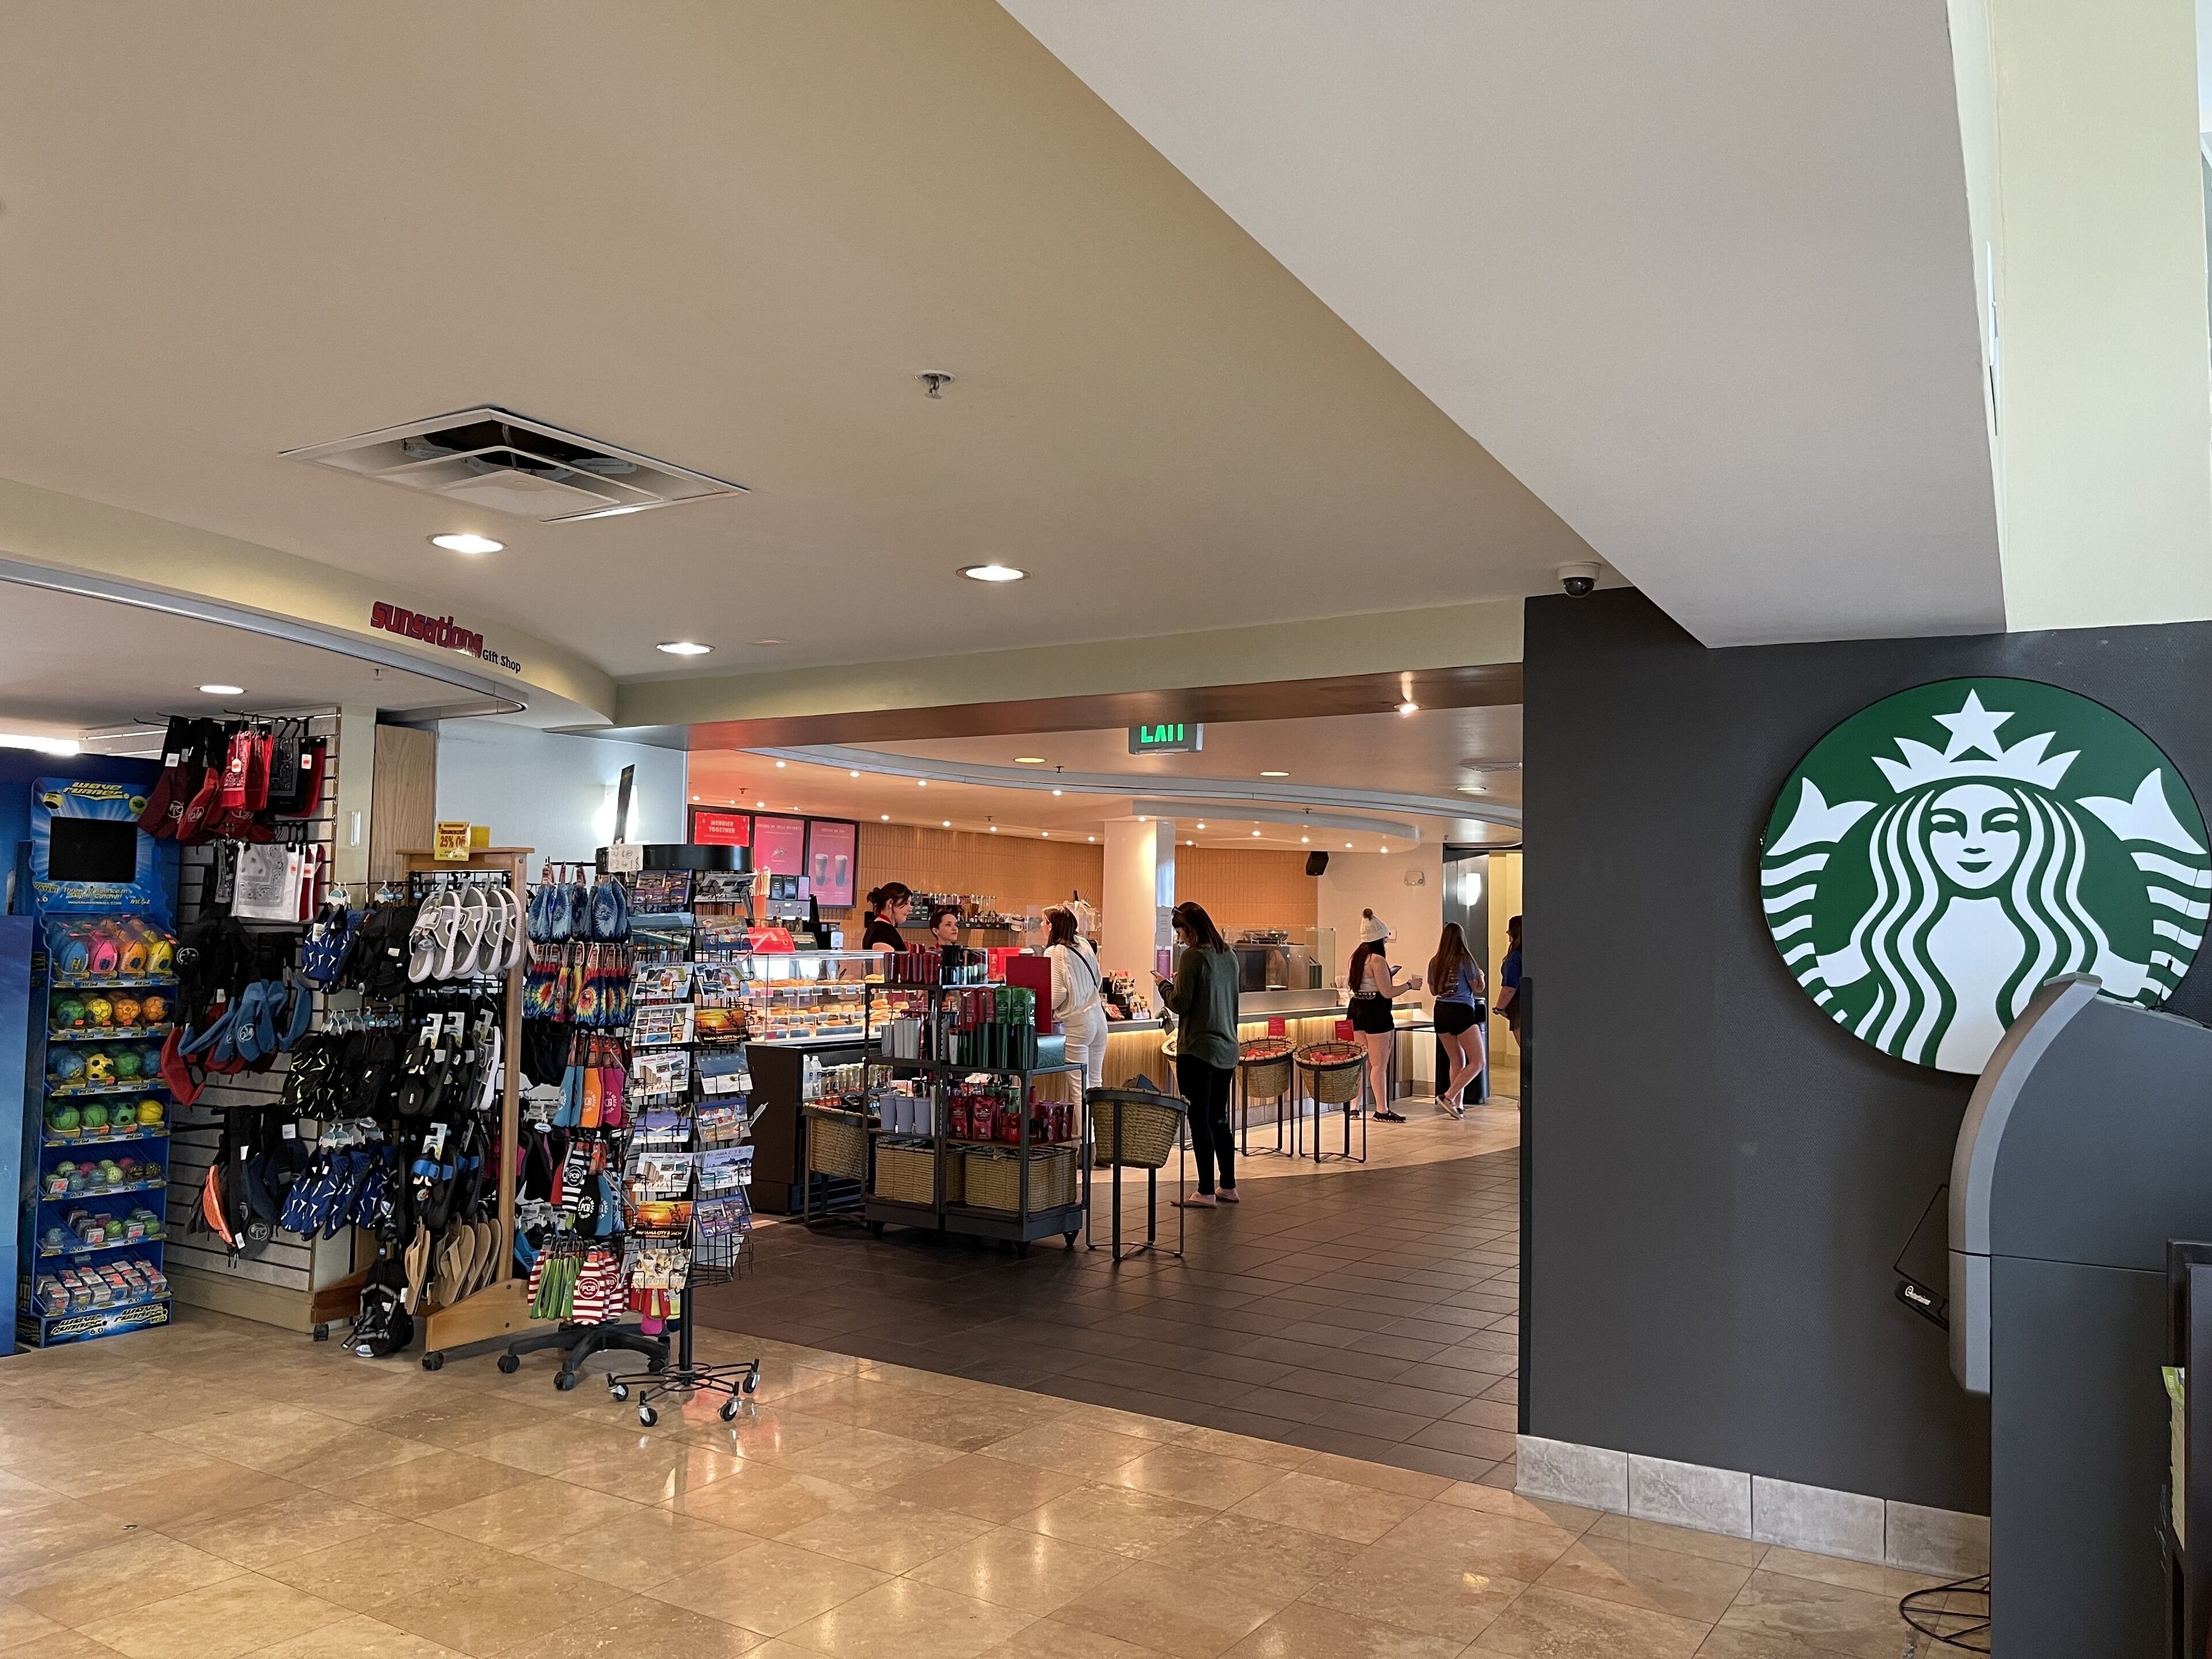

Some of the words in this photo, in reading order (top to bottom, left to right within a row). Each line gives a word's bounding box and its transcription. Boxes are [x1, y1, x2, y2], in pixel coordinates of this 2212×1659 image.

[370, 601, 484, 658] sunsations
[482, 649, 499, 664] Gift
[501, 656, 521, 674] Shop
[709, 826, 735, 834] TOGETHER
[440, 835, 454, 849] 25%
[580, 1203, 591, 1212] PCB
[89, 1327, 104, 1335] 6.0
